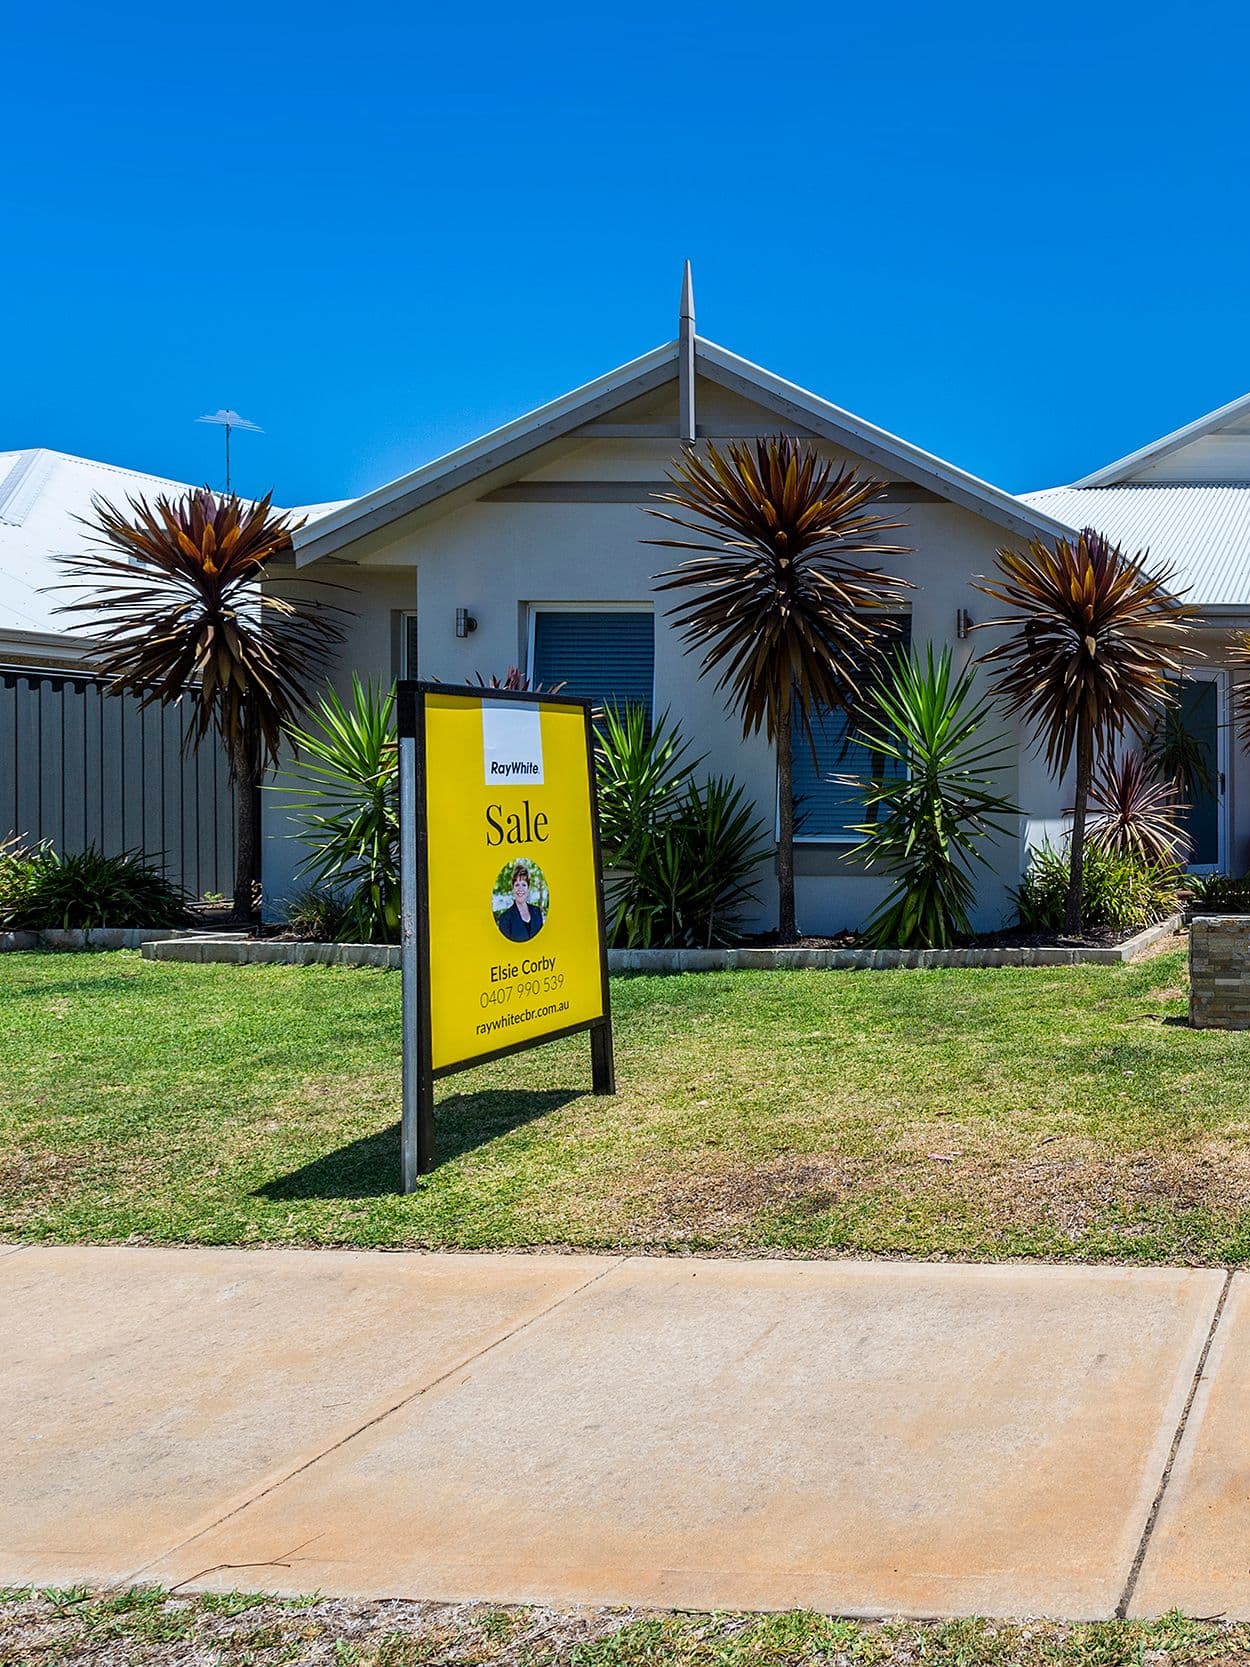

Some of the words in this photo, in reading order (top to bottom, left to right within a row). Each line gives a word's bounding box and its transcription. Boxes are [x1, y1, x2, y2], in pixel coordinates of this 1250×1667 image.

[486, 800, 549, 846] Sale
[491, 963, 519, 982] Elsie
[522, 955, 556, 975] Corby
[480, 986, 513, 1008] 0407
[517, 980, 540, 999] 990
[544, 974, 564, 993] 539
[476, 1001, 569, 1035] raywhitecbr.com.au
